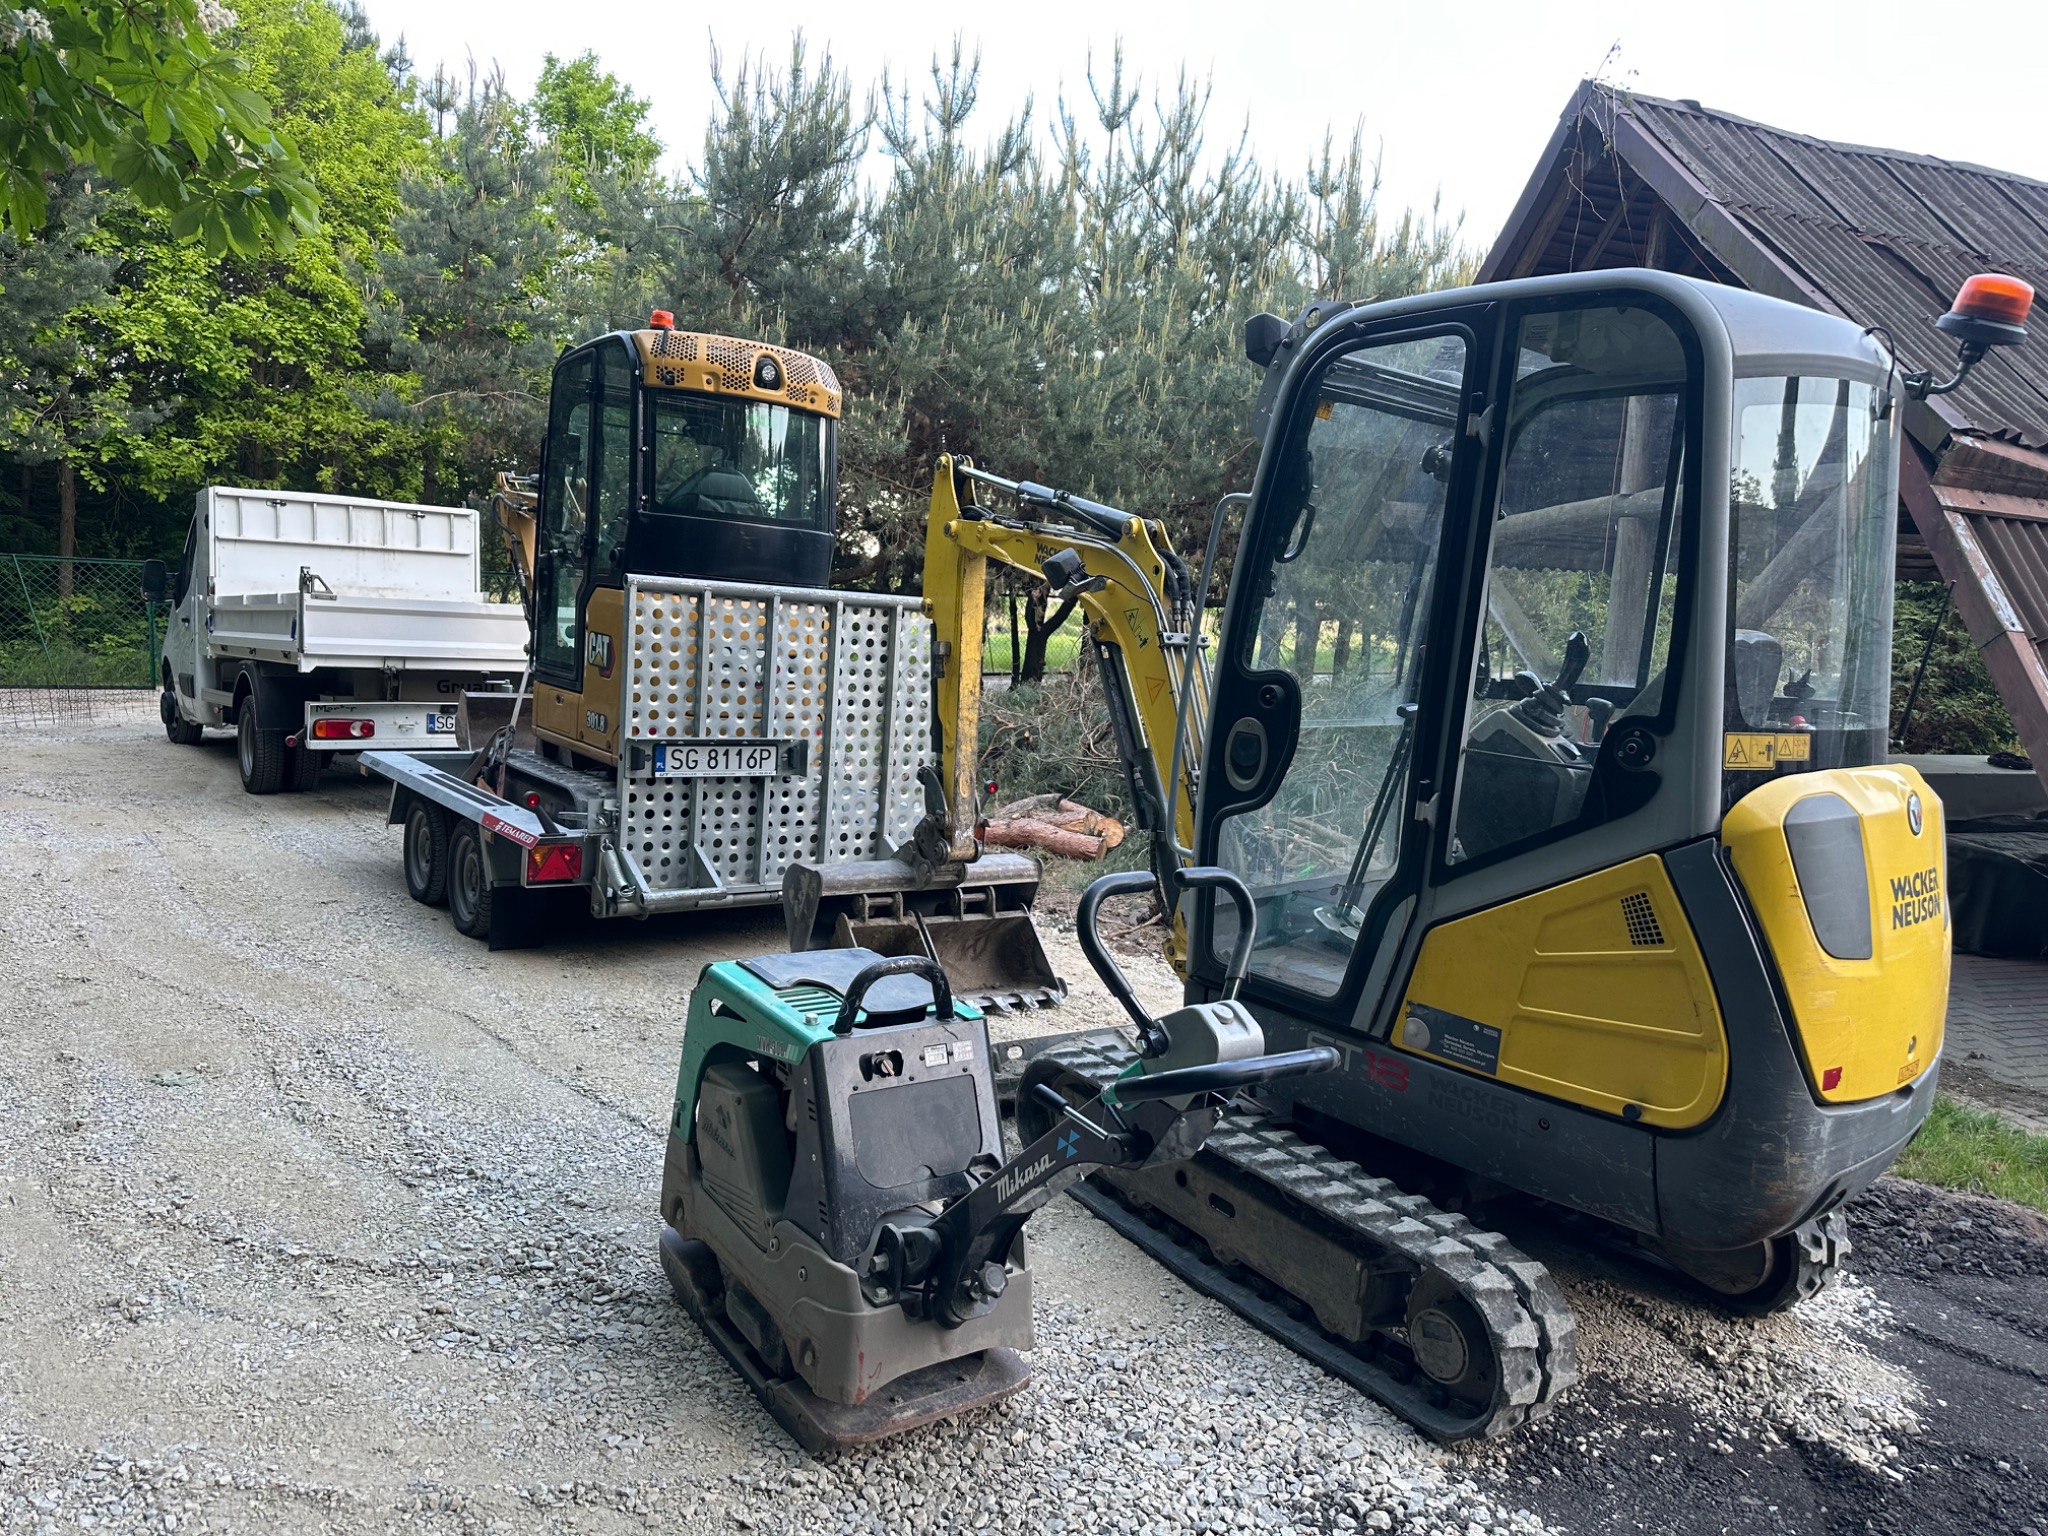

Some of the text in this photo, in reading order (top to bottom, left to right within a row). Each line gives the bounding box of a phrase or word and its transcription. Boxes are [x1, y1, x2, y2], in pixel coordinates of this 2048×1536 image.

[1036, 542, 1061, 557] WACK
[588, 632, 610, 668] CAT
[436, 716, 454, 730] SG
[586, 710, 606, 734] 301.8
[670, 748, 772, 770] SG 8116P
[500, 822, 535, 845] TEMARED
[1889, 866, 1940, 903] WACKER
[1891, 891, 1941, 931] NEUSON
[1427, 1090, 1519, 1135] NEUSON
[1428, 1073, 1518, 1117] WACKER
[990, 1153, 1057, 1204] Mikasa
